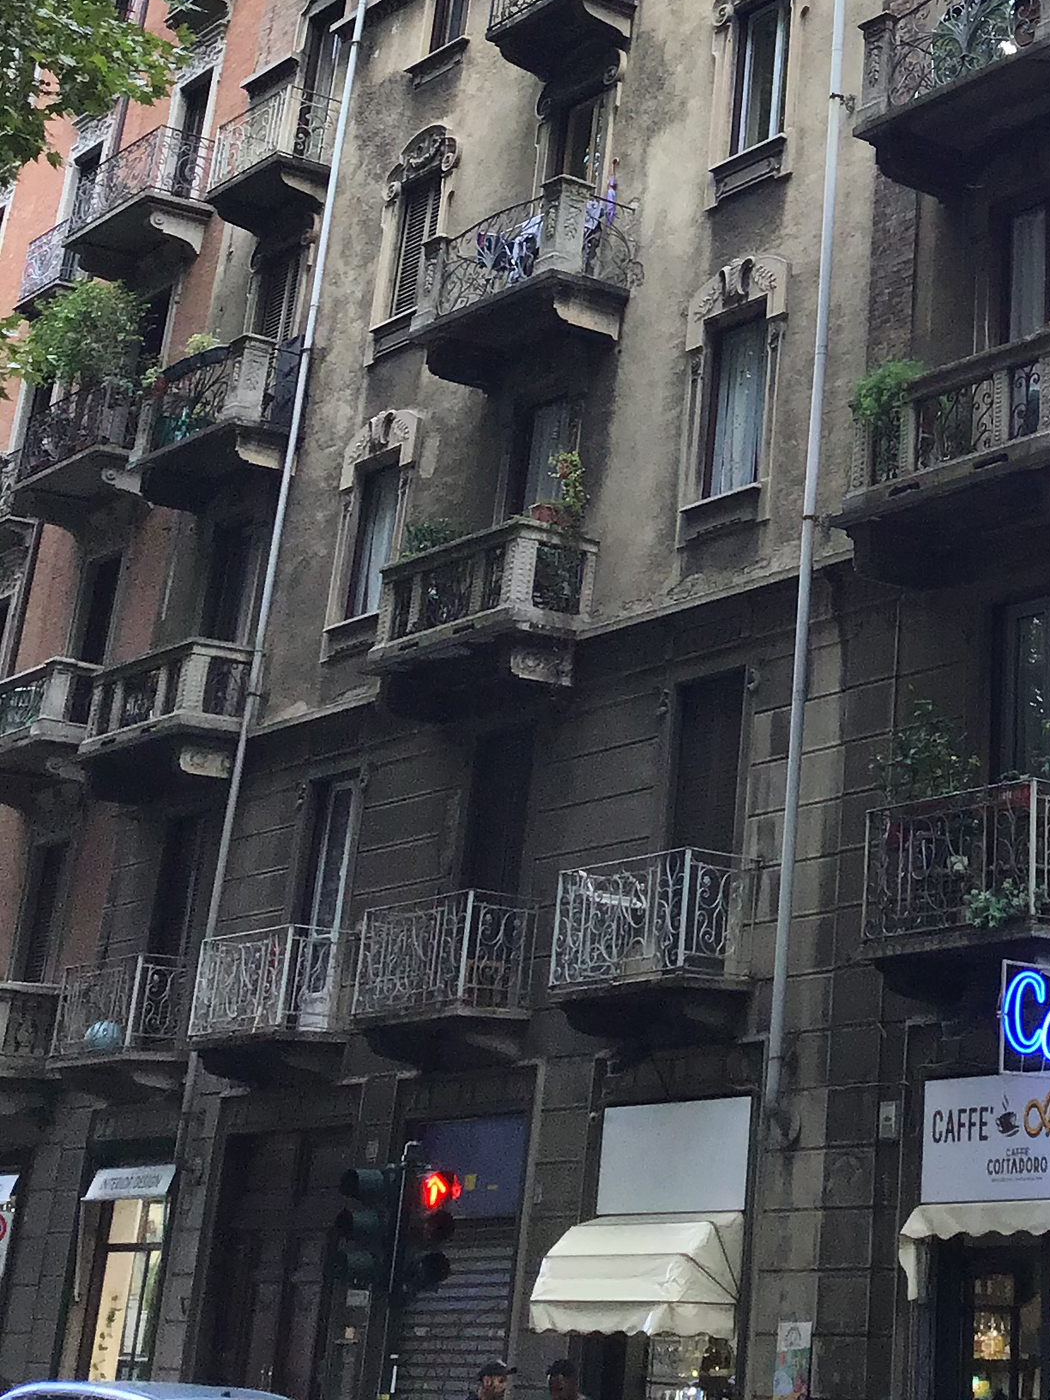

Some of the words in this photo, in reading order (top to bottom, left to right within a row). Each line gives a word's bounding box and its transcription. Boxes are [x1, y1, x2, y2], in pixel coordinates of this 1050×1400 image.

[932, 1107, 994, 1143] CAFFE'
[987, 1156, 1048, 1175] COSTADORO
[133, 1174, 163, 1189] DESIGN
